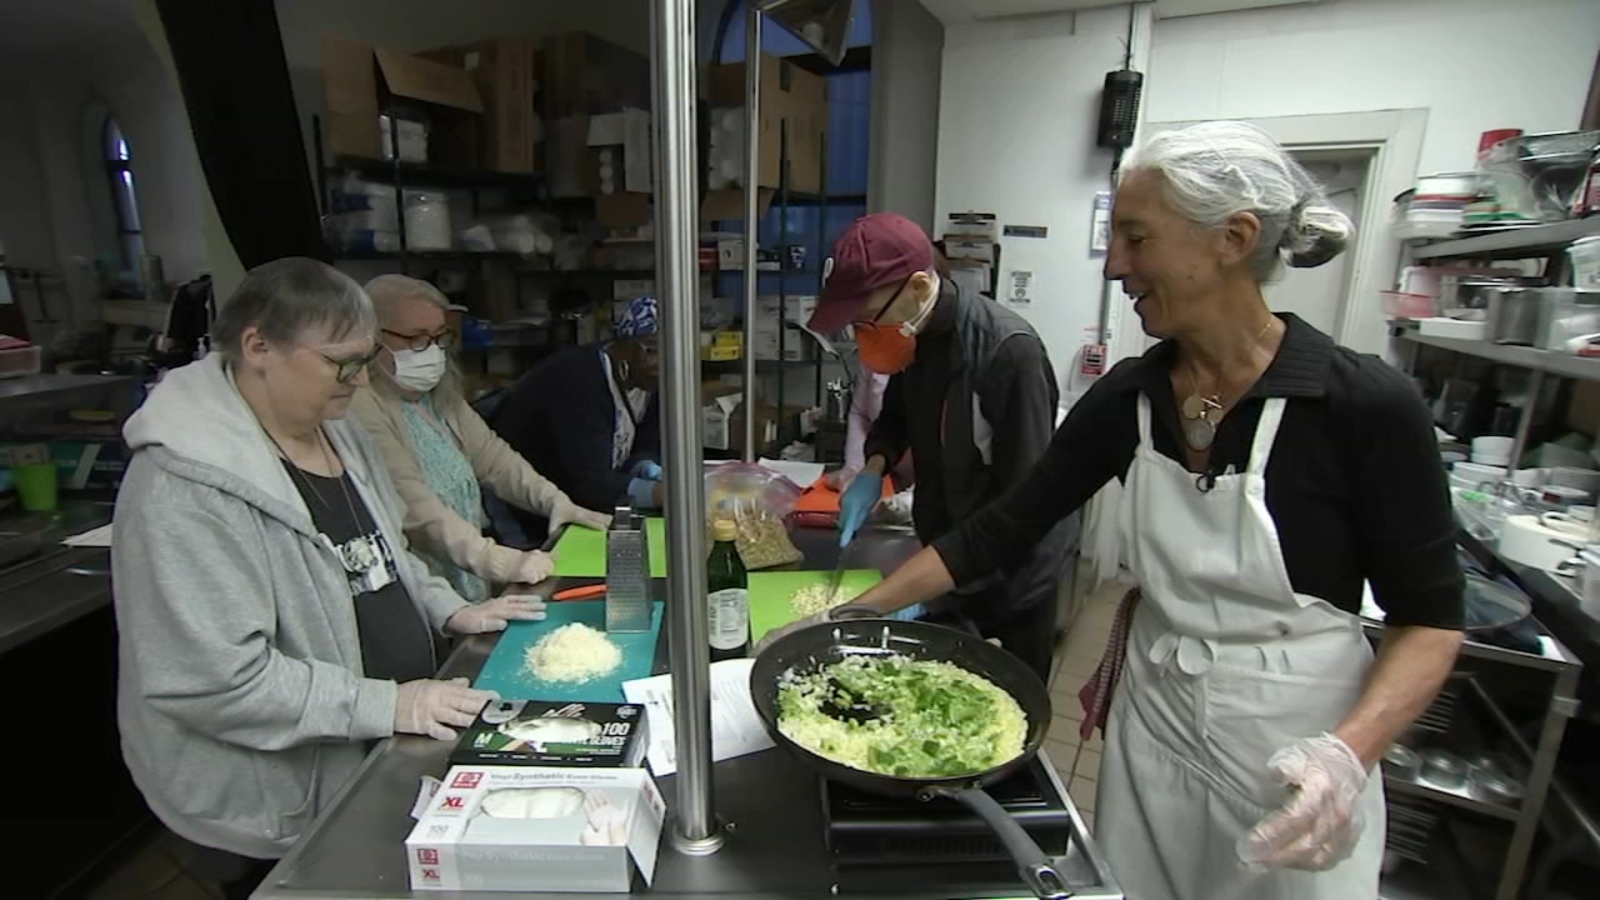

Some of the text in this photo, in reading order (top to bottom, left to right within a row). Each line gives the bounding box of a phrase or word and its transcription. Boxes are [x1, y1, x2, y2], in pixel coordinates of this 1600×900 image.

[602, 722, 630, 735] 100
[477, 733, 493, 744] M
[588, 736, 626, 746] GLOVES
[513, 772, 564, 782] Synthetic
[443, 797, 464, 808] XL
